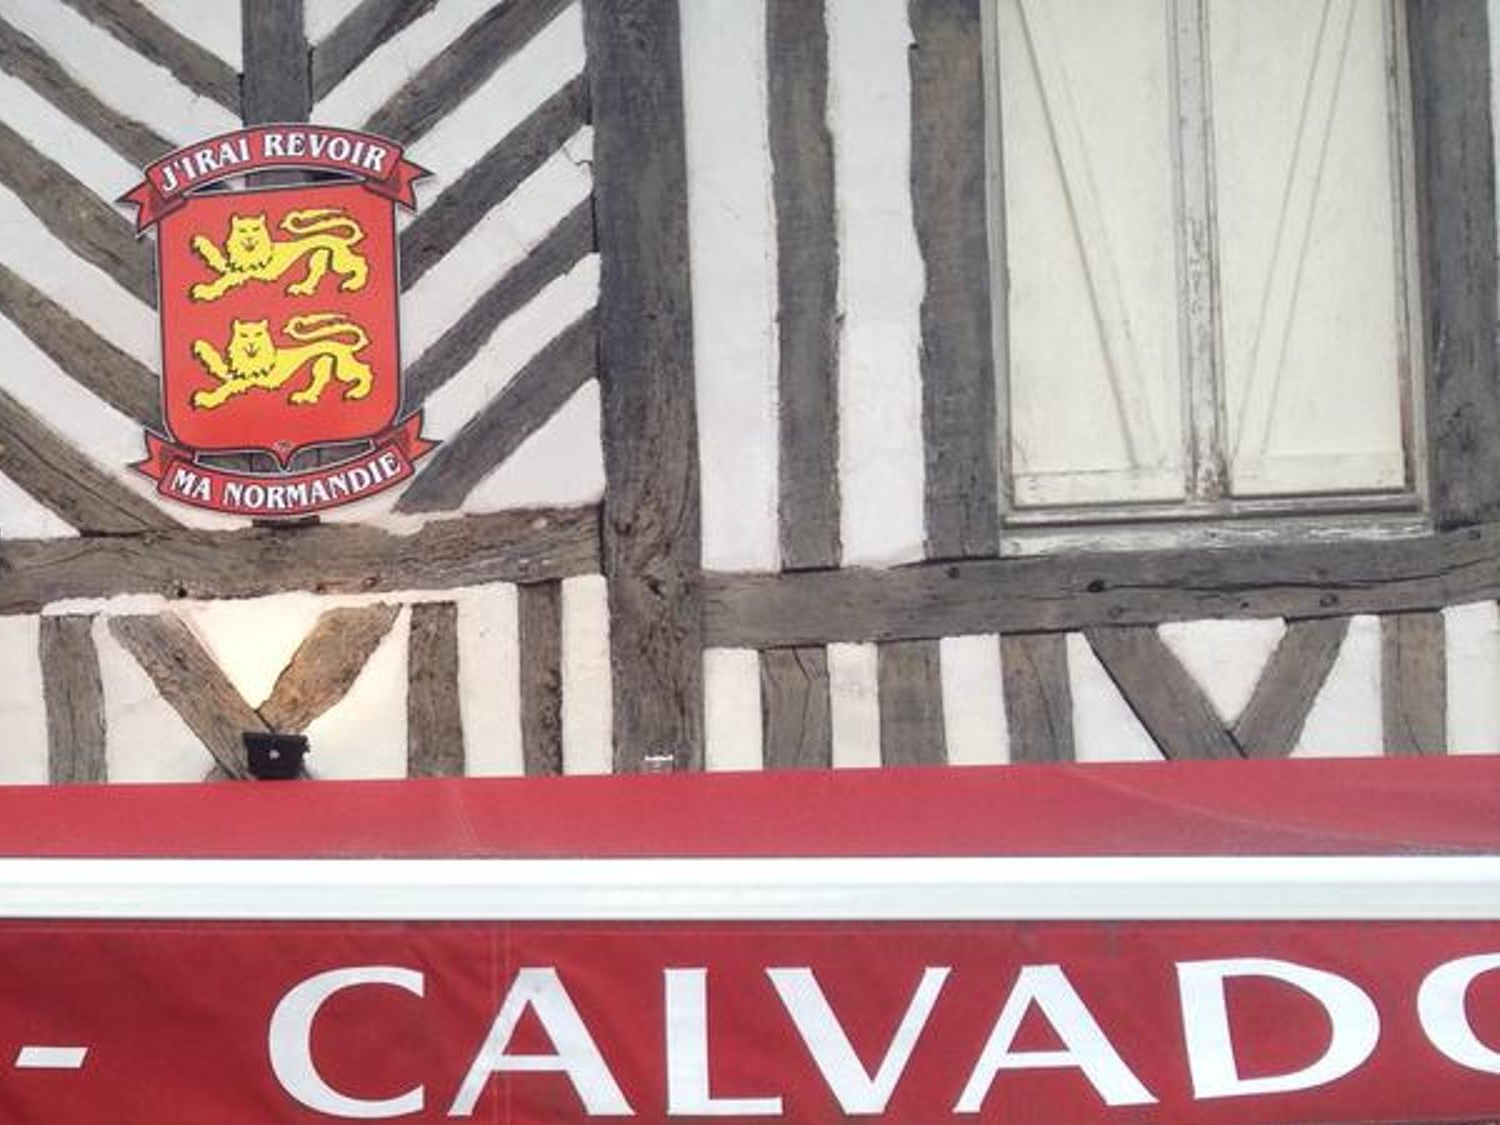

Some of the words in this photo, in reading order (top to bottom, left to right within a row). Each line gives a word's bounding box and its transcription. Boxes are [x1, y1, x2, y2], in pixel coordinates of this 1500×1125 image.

[162, 138, 250, 193] J'IRAI
[263, 133, 388, 173] REVOIR
[170, 468, 211, 499] MA
[223, 450, 402, 510] NORMANDIE
